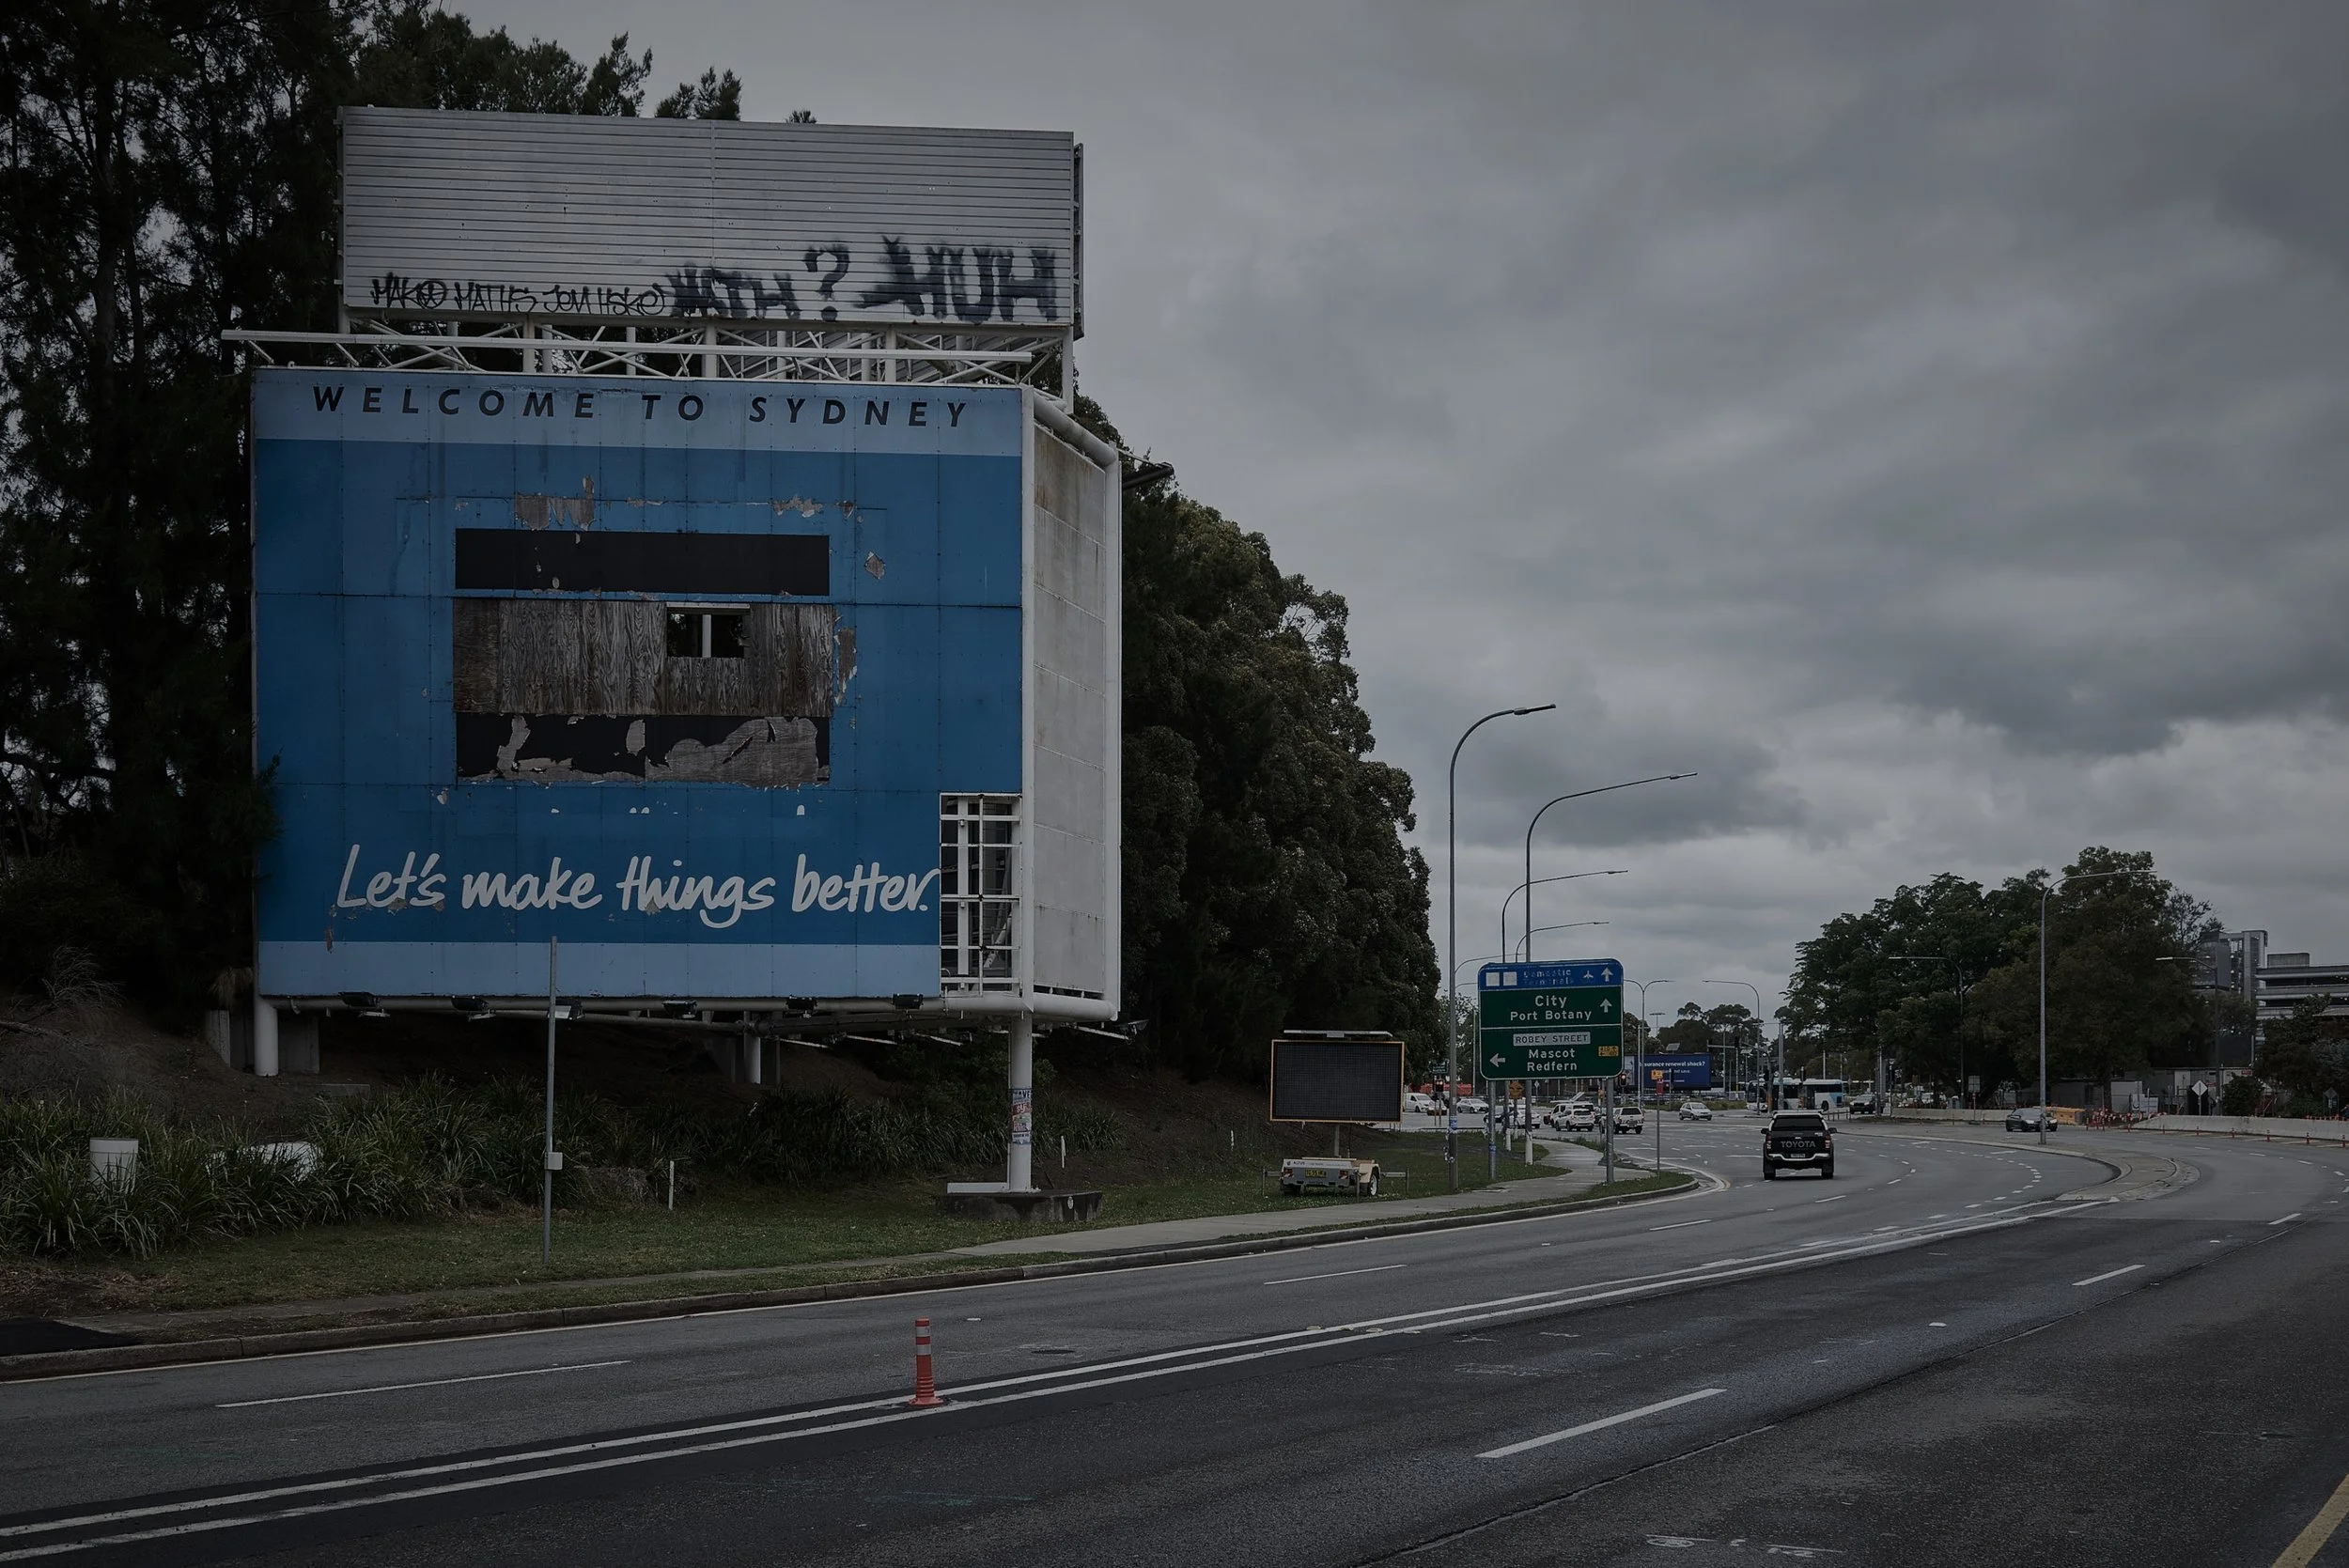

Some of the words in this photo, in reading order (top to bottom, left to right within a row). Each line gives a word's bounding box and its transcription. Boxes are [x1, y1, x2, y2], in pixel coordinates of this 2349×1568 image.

[313, 385, 595, 420] WELCOME
[642, 394, 705, 422] TO
[749, 396, 968, 427] SYDNEY
[335, 844, 446, 908] Let's
[461, 856, 604, 910] make
[616, 855, 776, 929] things
[791, 853, 941, 913] better.
[1534, 994, 1567, 1009] City
[1510, 1011, 1538, 1021] Port
[1545, 1009, 1593, 1021] Botany
[1515, 1035, 1548, 1044] ROBEY
[1552, 1034, 1589, 1043] STREET
[1528, 1048, 1576, 1059] Mascot
[1527, 1062, 1578, 1072] Redfern
